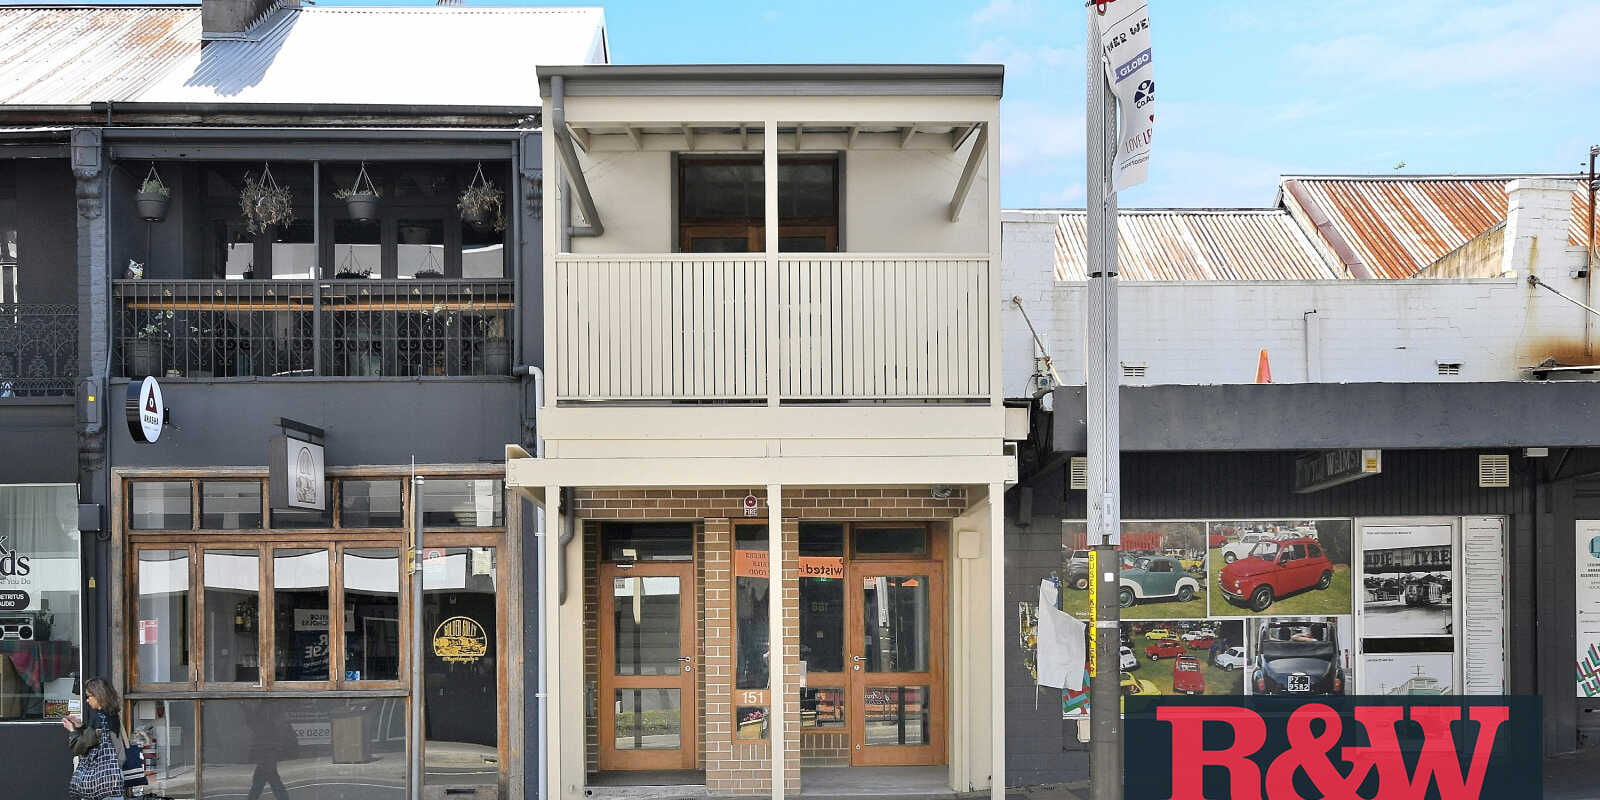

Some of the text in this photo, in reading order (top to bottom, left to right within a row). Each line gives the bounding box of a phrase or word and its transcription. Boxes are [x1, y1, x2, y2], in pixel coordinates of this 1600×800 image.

[1120, 53, 1149, 76] GLOBO
[1125, 134, 1144, 153] LOVE
[745, 508, 757, 516] FIRE
[742, 691, 763, 704] 151
